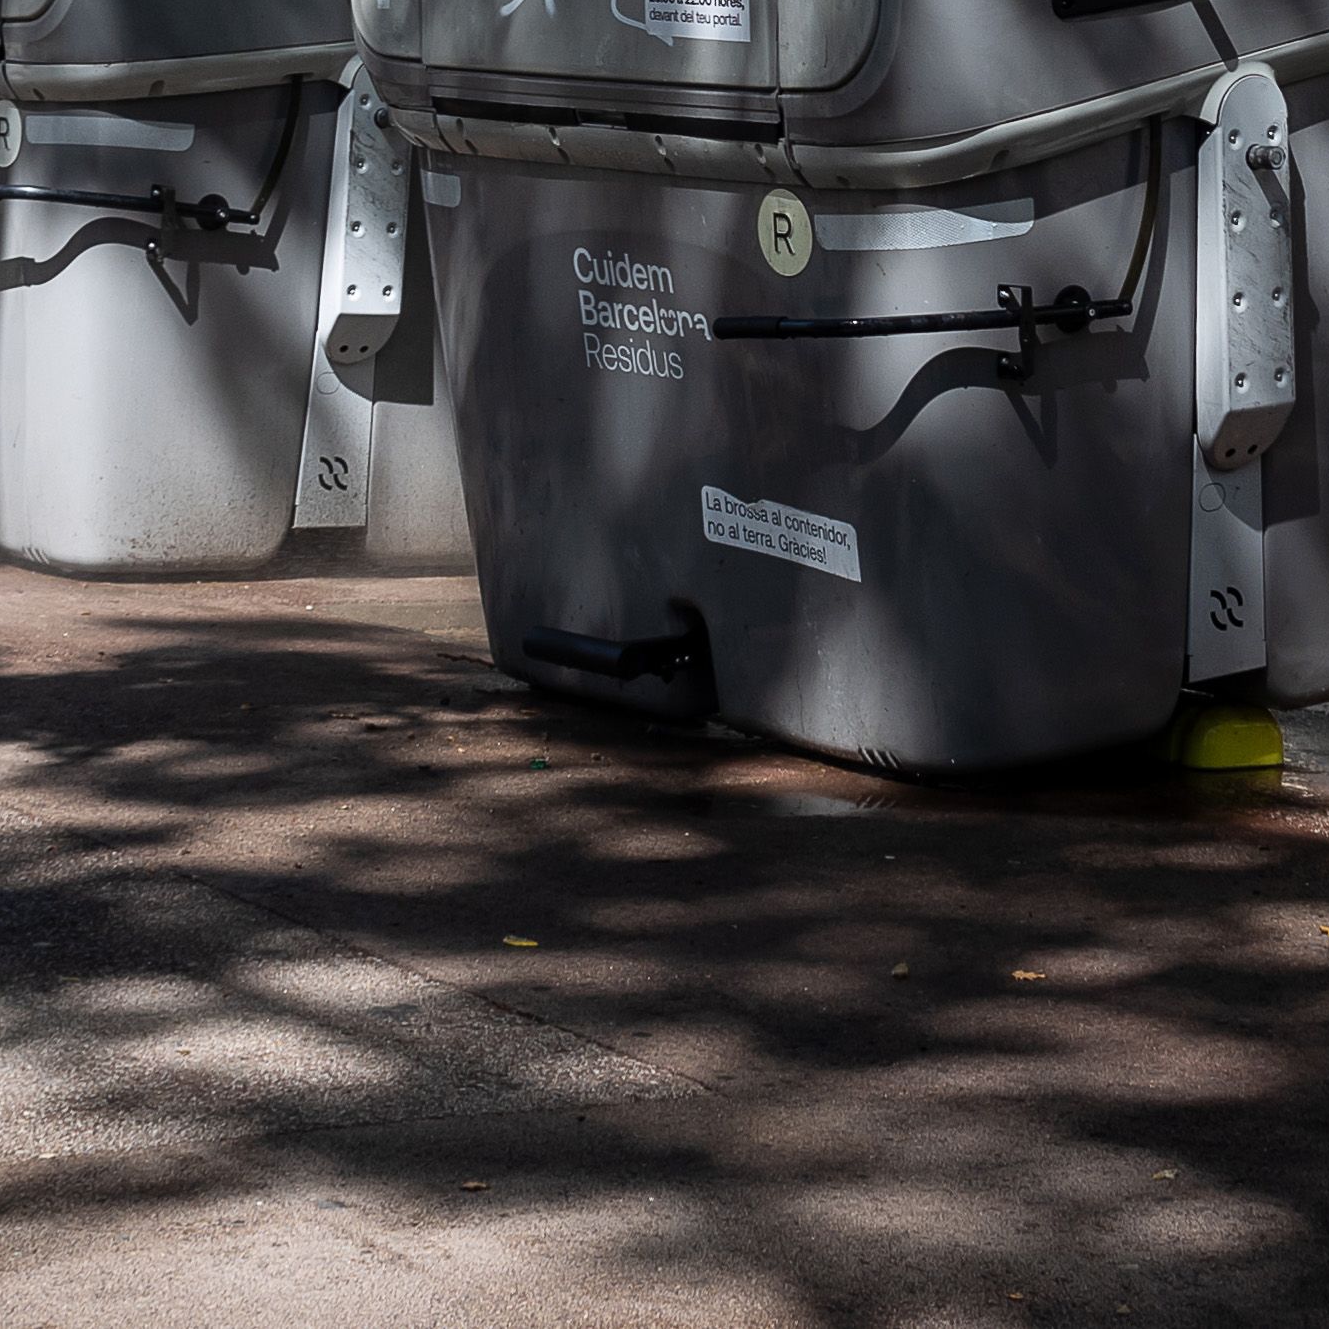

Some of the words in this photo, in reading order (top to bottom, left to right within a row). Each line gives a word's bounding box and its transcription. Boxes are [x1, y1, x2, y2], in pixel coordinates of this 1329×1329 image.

[649, 8, 679, 23] davant
[680, 9, 694, 23] del
[696, 11, 711, 24] teu
[773, 214, 796, 255] R
[573, 247, 674, 294] Cuidem
[578, 289, 713, 342] Barcelona
[583, 332, 684, 379] Residus
[705, 492, 722, 512] La
[724, 496, 769, 523] brossa
[771, 509, 782, 527] al
[784, 515, 851, 551] contenidor,
[707, 520, 725, 537] no
[728, 523, 740, 540] al
[742, 526, 776, 549] terra.
[778, 533, 827, 565] Gràcies!
